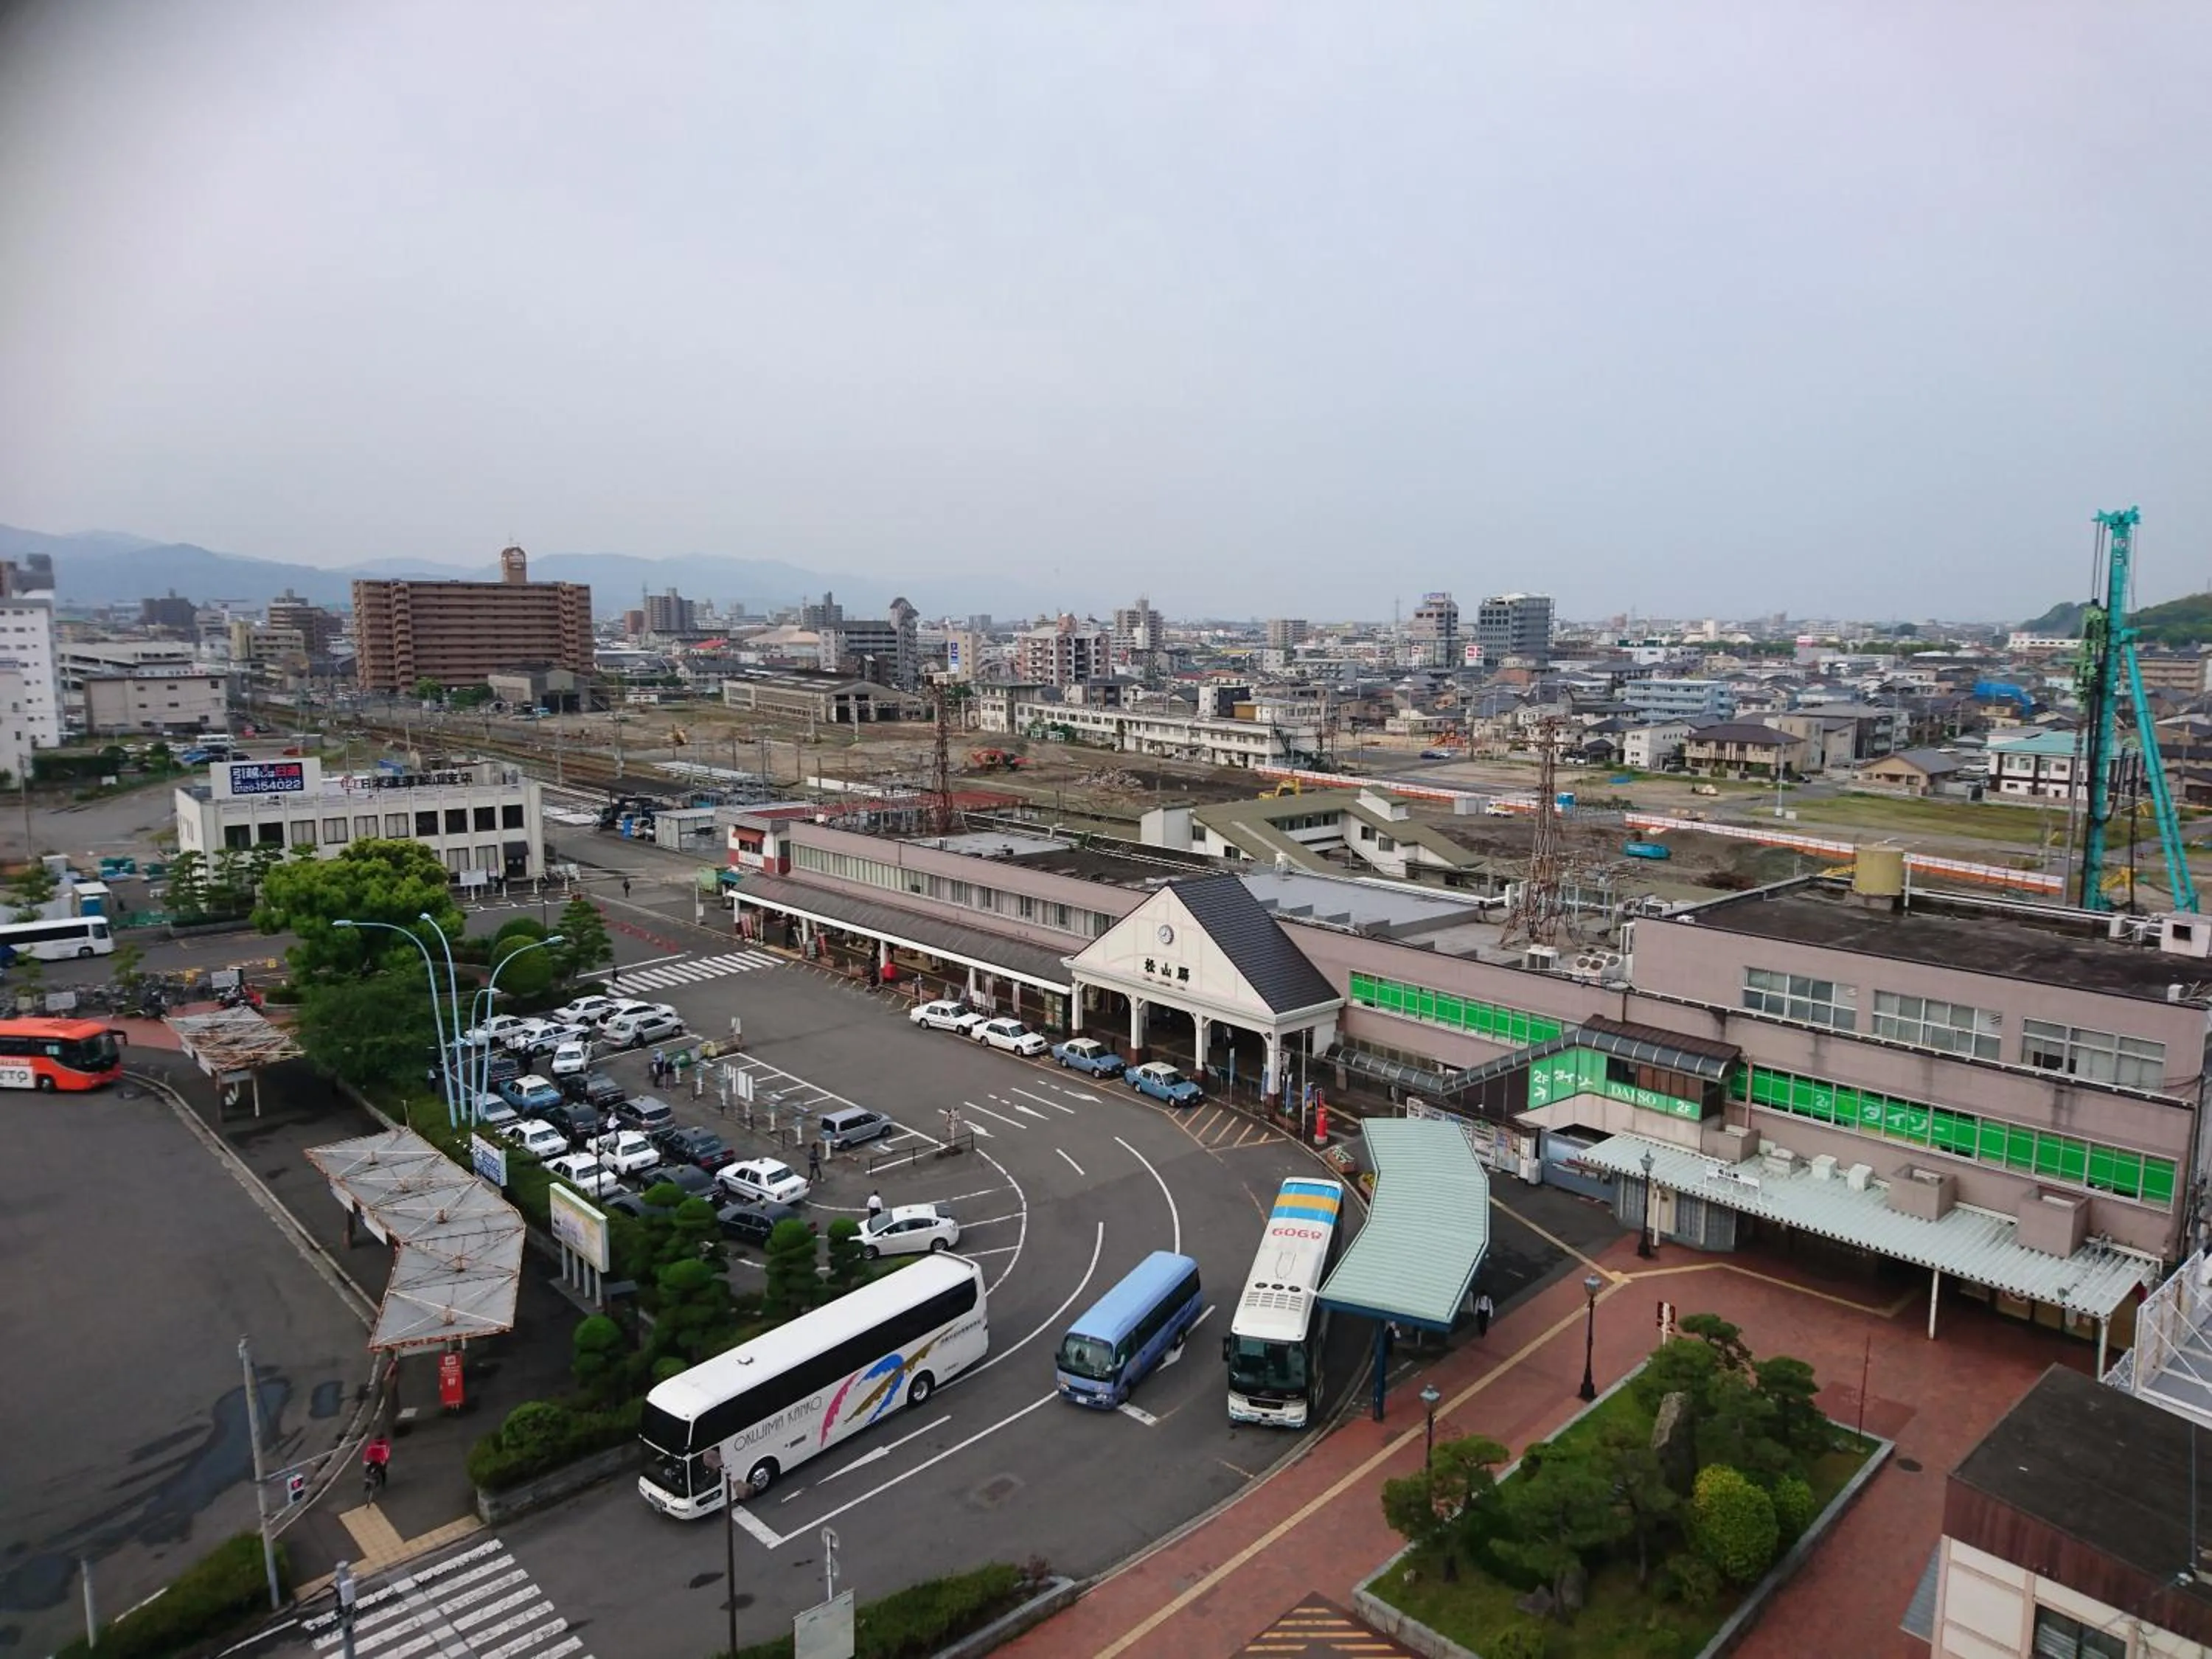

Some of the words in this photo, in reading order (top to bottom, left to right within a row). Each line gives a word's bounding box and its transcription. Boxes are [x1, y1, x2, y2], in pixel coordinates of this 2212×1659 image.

[1144, 957, 1190, 983] 松山駅
[1610, 1084, 1657, 1106] DAISO
[1676, 1099, 1691, 1114] 2F
[1863, 1105, 1946, 1133] ダイソー
